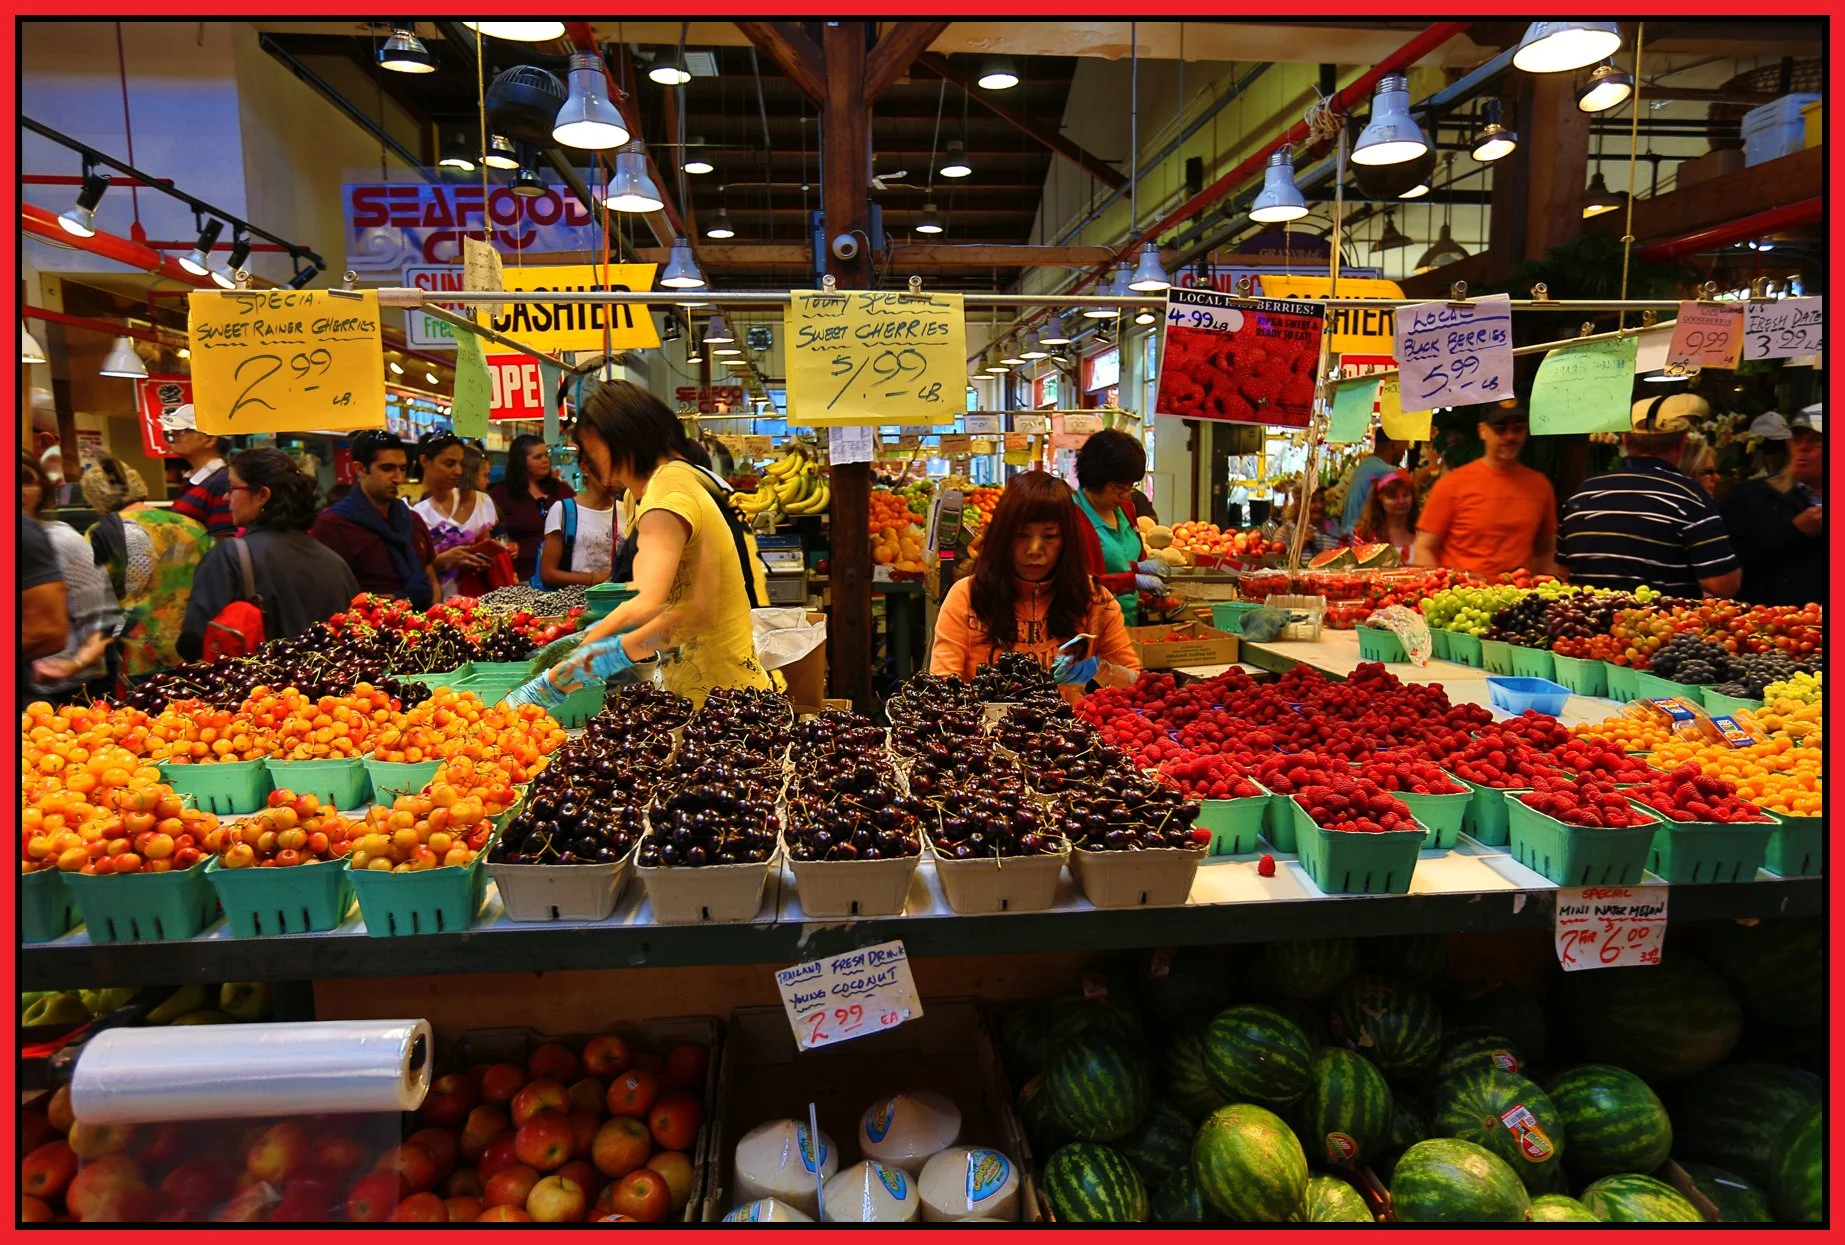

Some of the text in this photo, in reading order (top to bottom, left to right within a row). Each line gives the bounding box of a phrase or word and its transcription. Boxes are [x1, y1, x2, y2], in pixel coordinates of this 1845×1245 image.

[352, 187, 593, 227] SEAFOOD
[1179, 291, 1223, 306] LOCAL
[1168, 306, 1213, 328] 4.99
[1413, 308, 1474, 329] LOCAL
[1749, 314, 1789, 331] FRESH
[198, 318, 376, 341] SWEET RAINER CHERRIES
[796, 319, 949, 349] SWEET CHERRIES
[1447, 329, 1506, 348] BERRIES
[490, 364, 544, 409] OPE
[1560, 904, 1589, 916] MINI
[1628, 901, 1664, 917] MELON
[1561, 929, 1579, 963] 2
[777, 962, 822, 984] THAILAND
[831, 953, 865, 974] FRESH
[789, 966, 897, 1009] YOUNG COCONUT
[880, 1012, 899, 1026] EA
